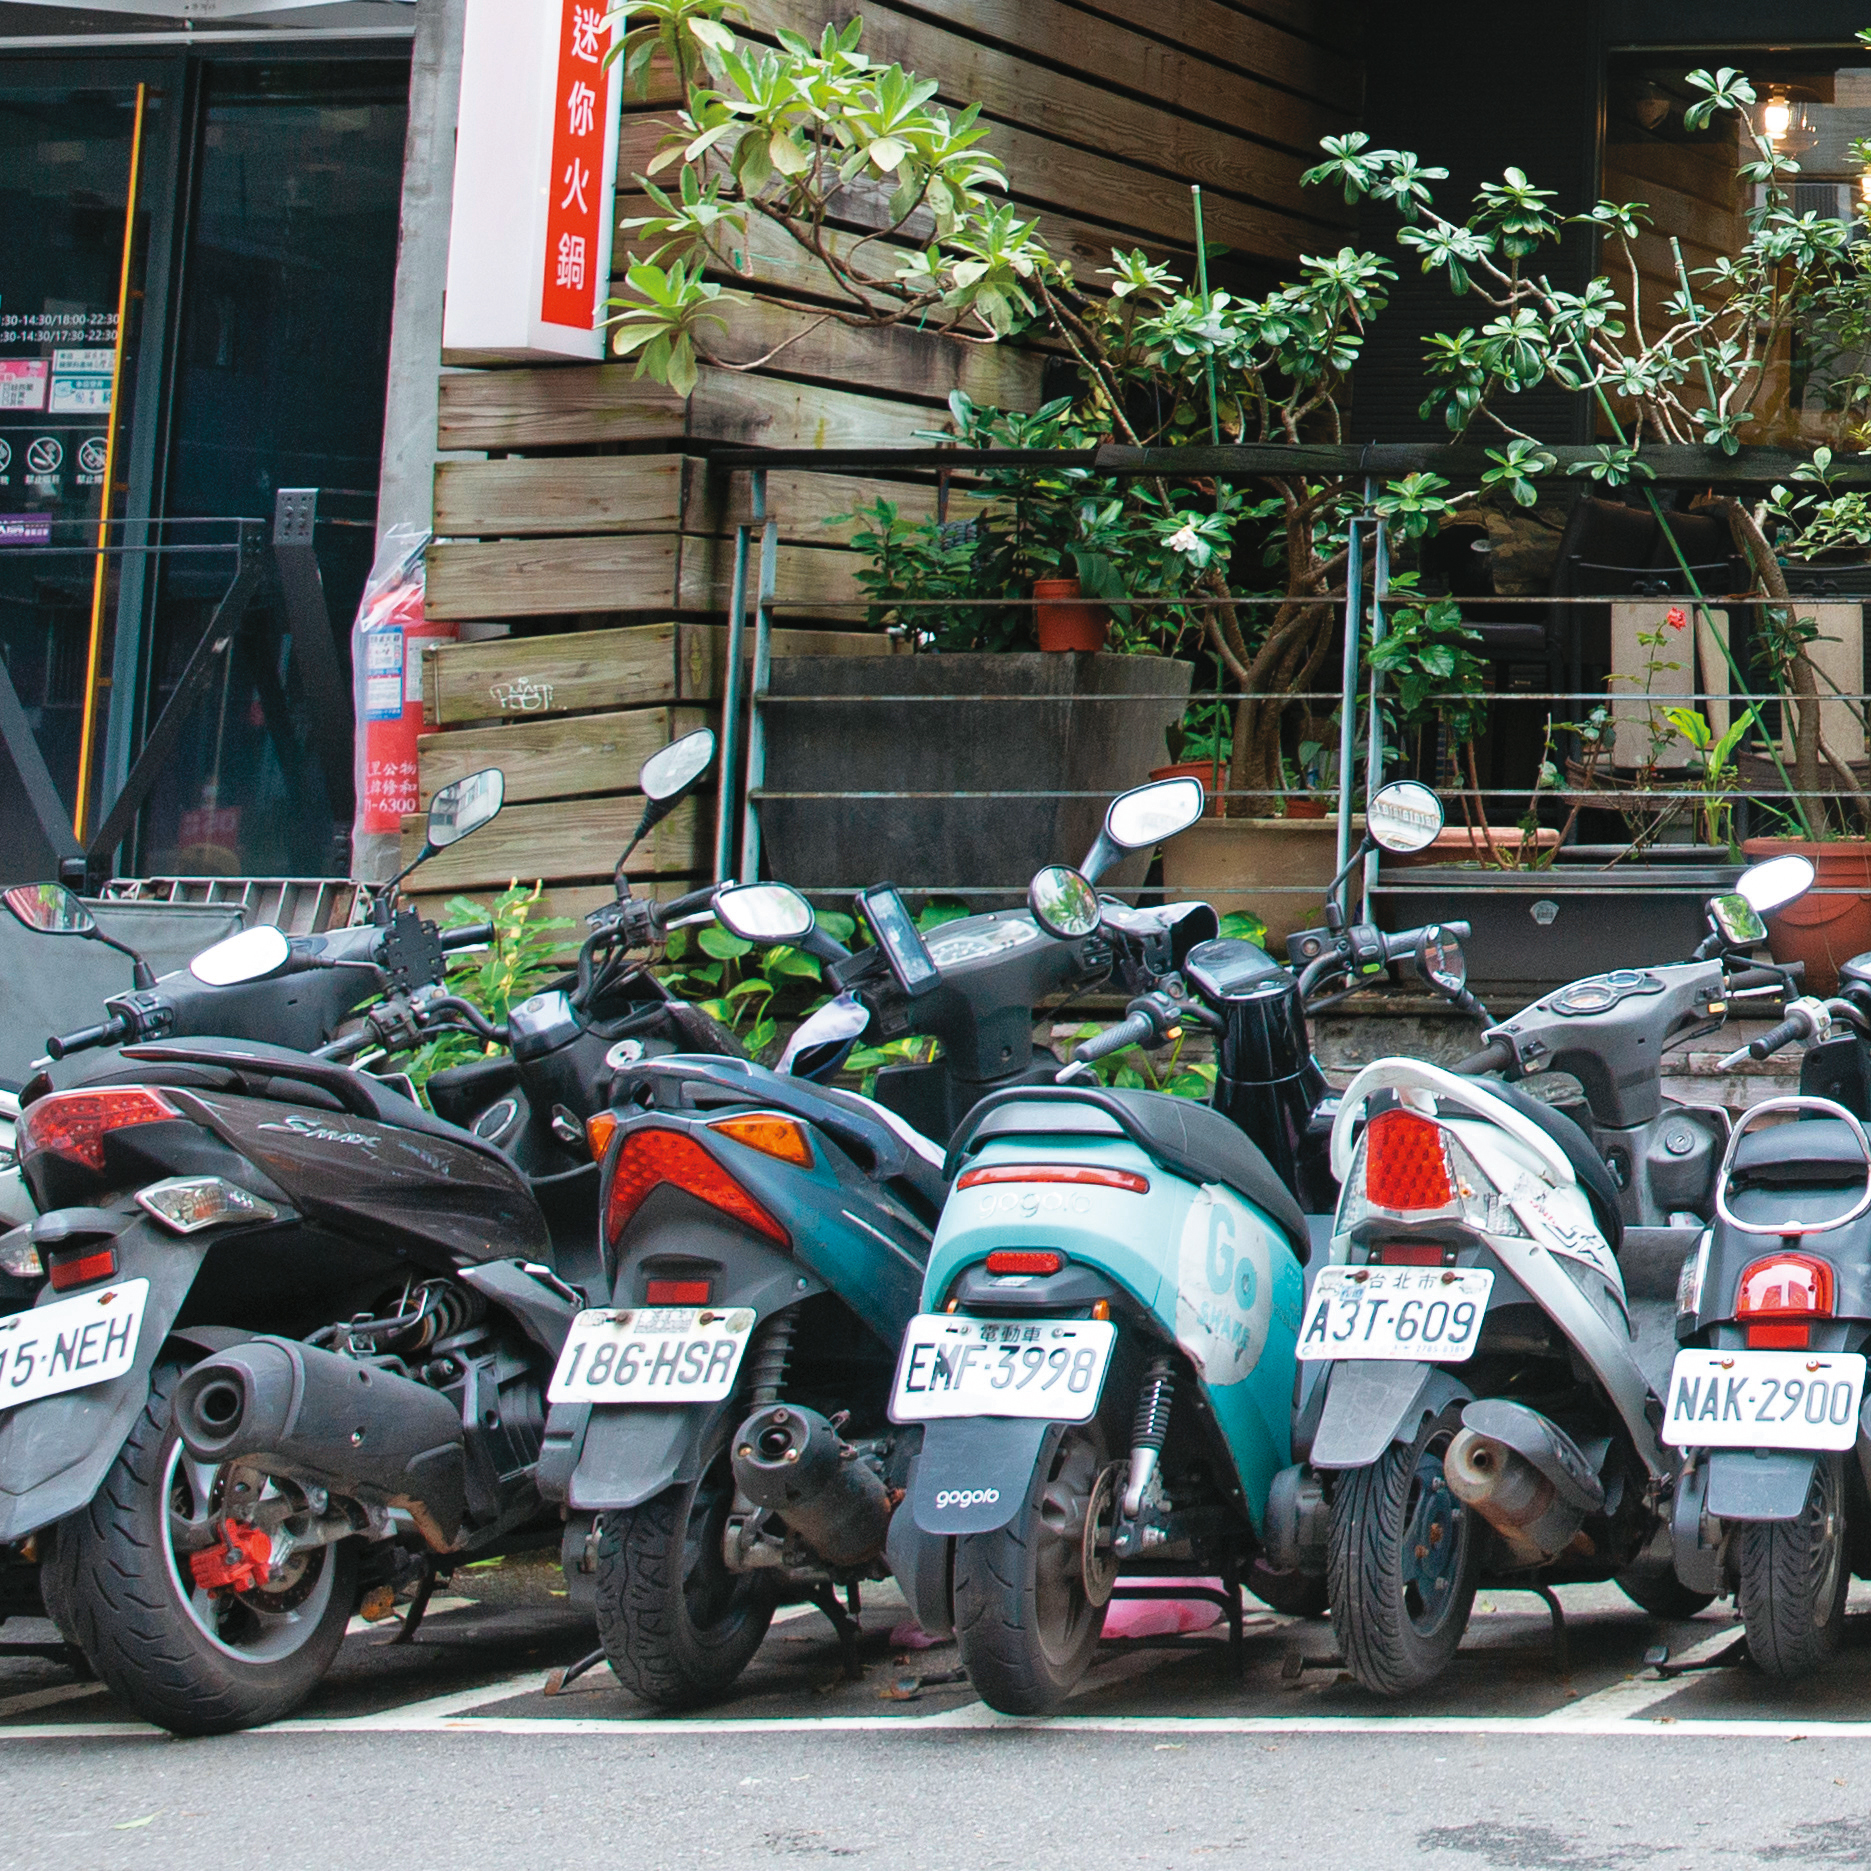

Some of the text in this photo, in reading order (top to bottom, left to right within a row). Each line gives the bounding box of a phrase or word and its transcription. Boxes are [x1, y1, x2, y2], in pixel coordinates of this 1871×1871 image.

[556, 4, 602, 292] 迷你火鍋
[1369, 1272, 1439, 1290] 台北市
[980, 1322, 1042, 1343] 電動車
[936, 1487, 1000, 1508] gogoro
